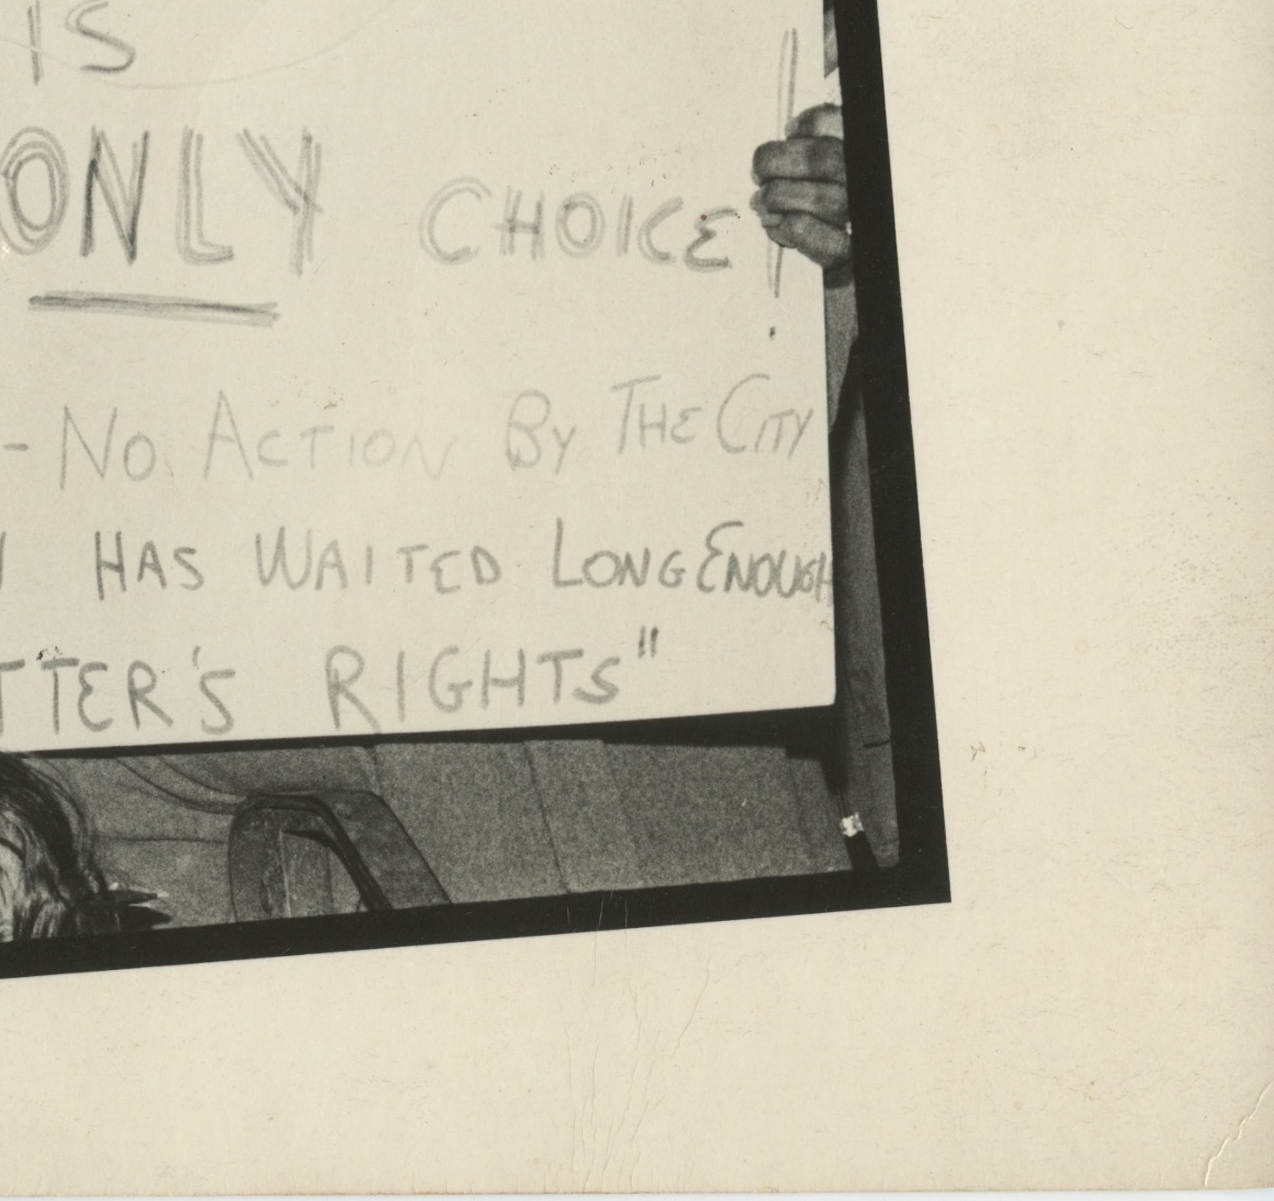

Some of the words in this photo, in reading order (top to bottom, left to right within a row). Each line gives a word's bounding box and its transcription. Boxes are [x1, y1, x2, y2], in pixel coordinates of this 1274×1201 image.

[93, 529, 205, 602] HAS
[255, 524, 502, 596] WAITED
[552, 517, 687, 588] LONG
[324, 625, 659, 735] RIGHTS"
